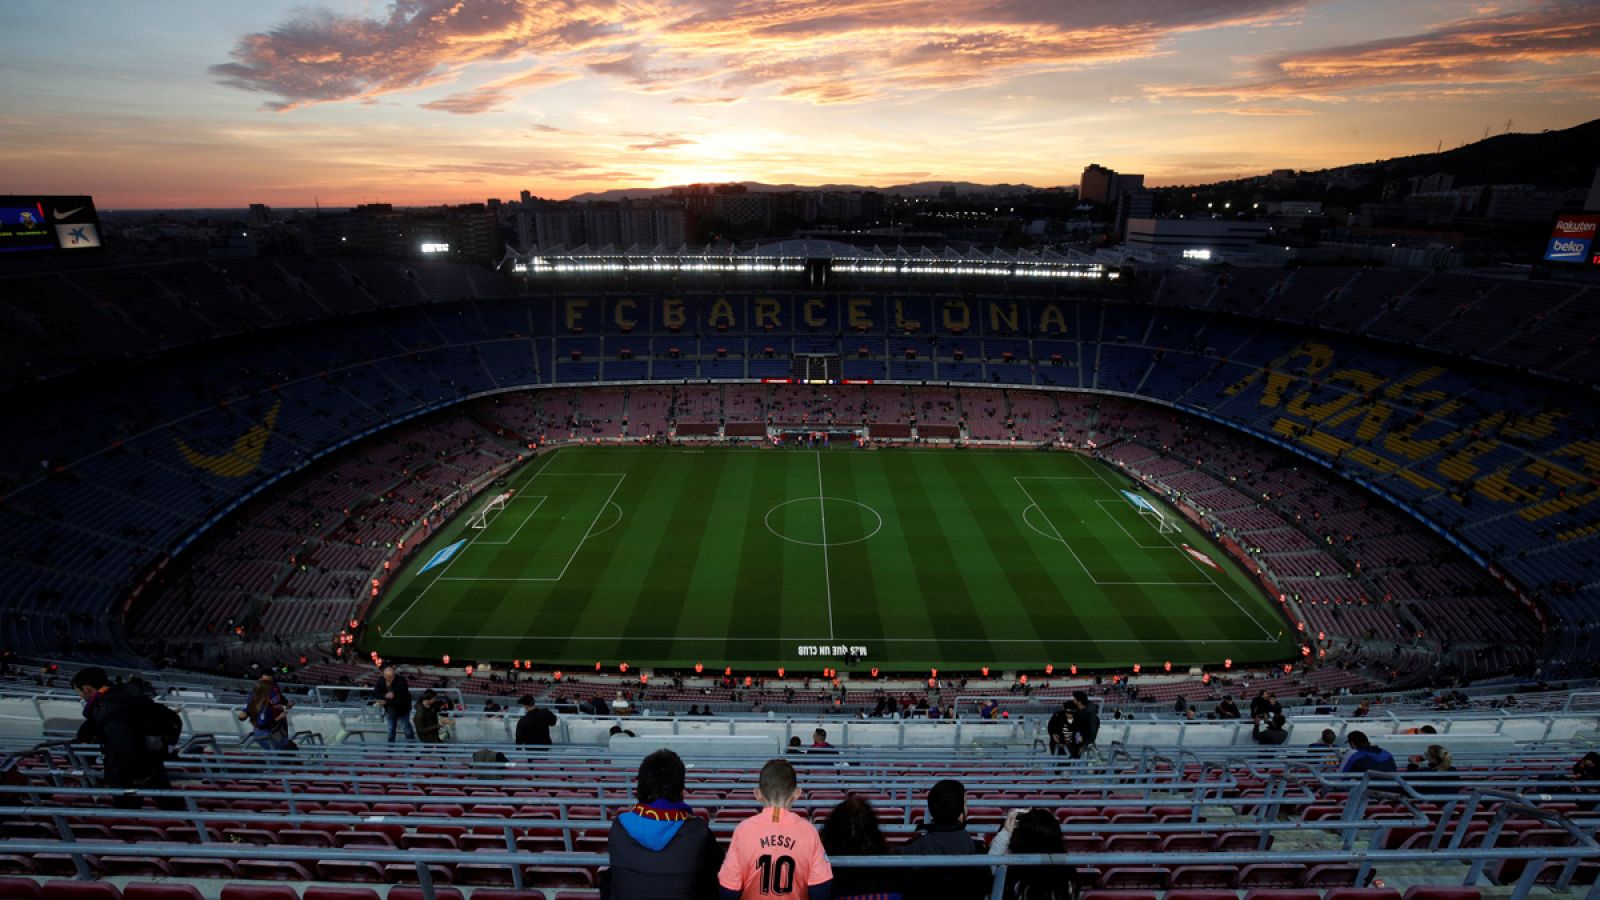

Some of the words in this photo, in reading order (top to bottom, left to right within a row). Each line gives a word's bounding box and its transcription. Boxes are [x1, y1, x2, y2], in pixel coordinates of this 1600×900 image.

[1555, 220, 1597, 232] Rakuten
[1552, 240, 1585, 252] beko
[662, 300, 1068, 334] BARCELONA
[798, 645, 818, 656] CLUB
[819, 645, 831, 656] UN
[832, 644, 848, 656] QUE
[760, 834, 796, 850] MESSI
[756, 854, 796, 895] 10
